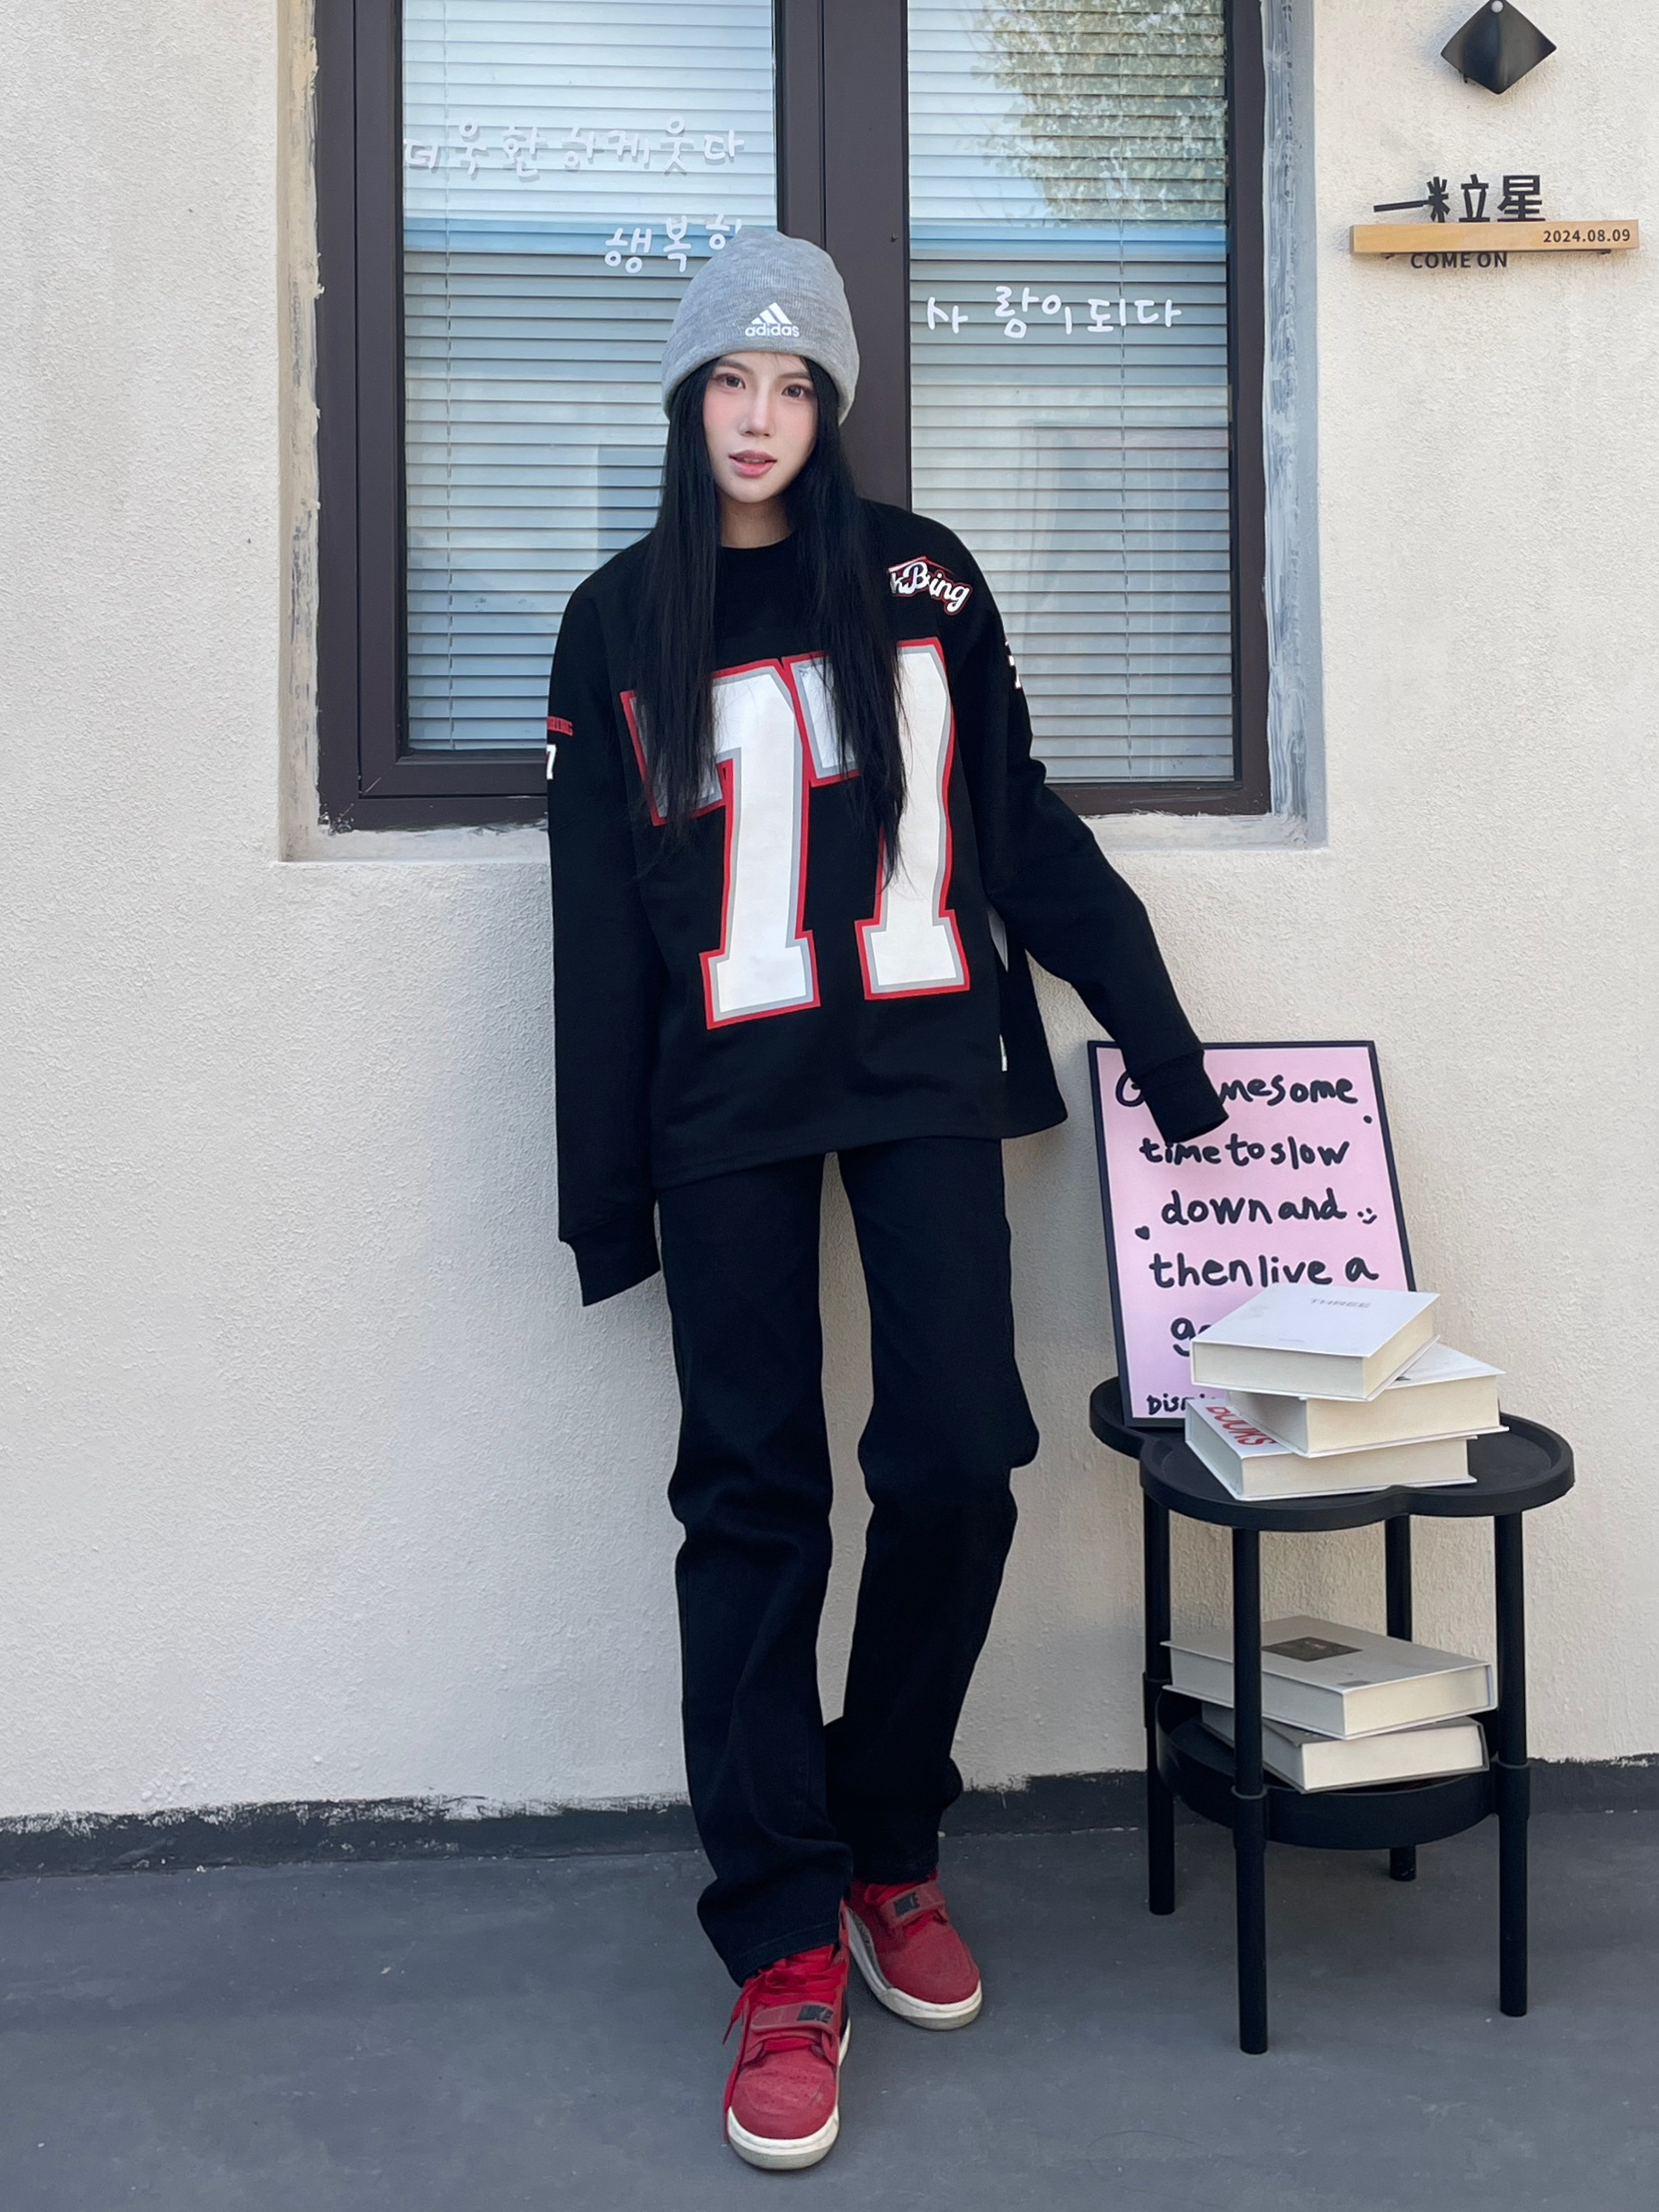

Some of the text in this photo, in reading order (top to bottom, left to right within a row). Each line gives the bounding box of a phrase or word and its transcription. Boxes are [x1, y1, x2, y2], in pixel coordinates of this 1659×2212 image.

[1542, 228, 1631, 244] 2024.08.09
[1409, 252, 1508, 269] COME ON
[744, 323, 800, 338] adidas
[1344, 1256, 1380, 1282] a
